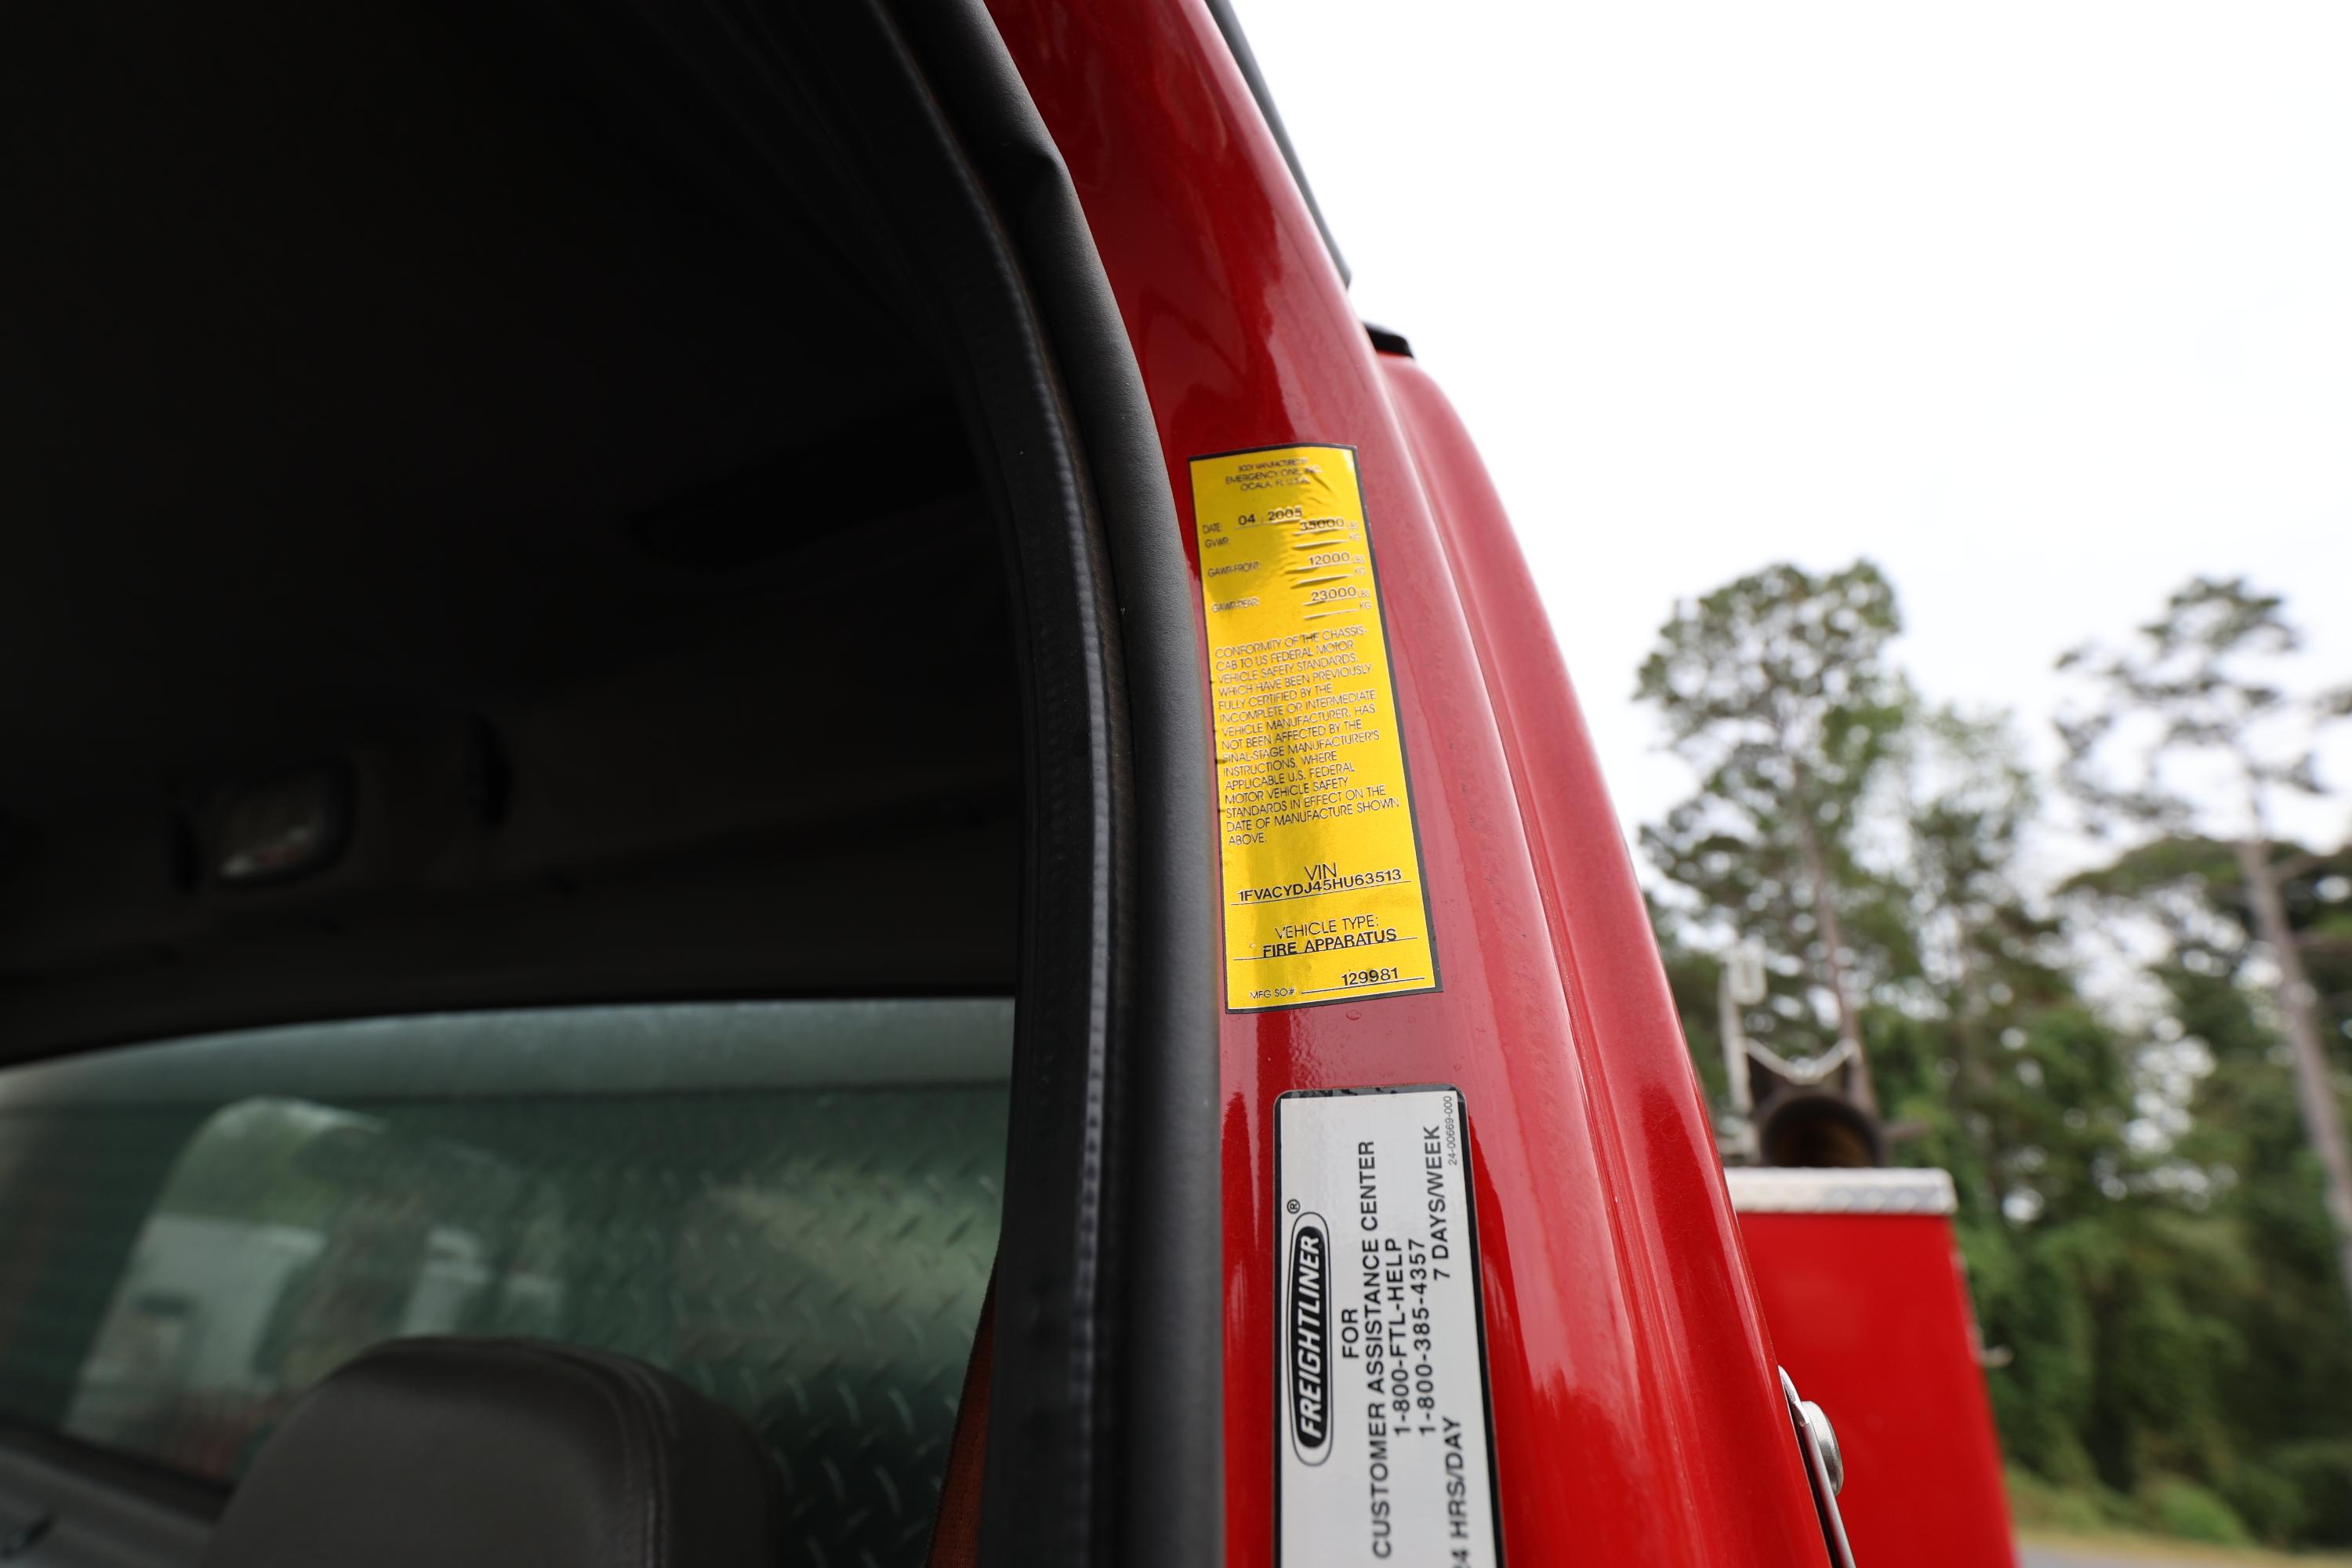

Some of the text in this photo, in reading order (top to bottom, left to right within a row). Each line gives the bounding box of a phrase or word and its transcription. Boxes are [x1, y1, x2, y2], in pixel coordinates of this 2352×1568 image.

[1225, 470, 1278, 485] EMERGENCY
[1238, 514, 1256, 525] 04
[1268, 507, 1302, 522] 2005
[1300, 517, 1345, 532] 35000
[1309, 551, 1350, 565] 12000
[1311, 586, 1356, 601] 23000
[1359, 601, 1372, 610] KG
[1215, 639, 1281, 658] CONFORMITY
[1284, 636, 1298, 647] OF
[1301, 632, 1319, 643] THE
[1216, 640, 1355, 671] CAB TO US FEDERAL MOTOR
[1218, 670, 1258, 684] VEHICLE
[1261, 663, 1294, 678] SAFETY
[1218, 663, 1372, 697] WHICH HAVE BEEN PREVIOUSLY
[1218, 683, 1332, 710] FULLY CERTIFIED BY THE
[1220, 689, 1377, 723] INCOMPLETE OR INTERMEDIATE
[1221, 722, 1263, 737] VEHICLE
[1354, 702, 1375, 716] HAS
[1221, 719, 1362, 750] NOT BEEN AFFECTED BY THE
[1222, 730, 1380, 764] FINAL-STAGE MANUFACTURER'S
[1301, 750, 1338, 765] WHERE
[1225, 762, 1355, 791] APPLICABLE U.S. FEDERAL
[1225, 776, 1348, 804] MOTOR VEHICLE SAFETY
[1226, 785, 1386, 818] STANDARDS IN EFFECT ON THE
[1226, 797, 1399, 833] DATE OF MANUFACTURE SHOWN
[1229, 832, 1267, 846] ABOVE.
[1238, 869, 1402, 902] 1FVACYDJ45HU63513
[1305, 862, 1338, 880] VIN
[1275, 914, 1379, 939] VEHICLE TYPE:
[1263, 928, 1397, 958] FIRE APPARATUS
[1341, 967, 1399, 986] 129981
[1250, 986, 1295, 999] MFG SO#
[1443, 1095, 1457, 1167] 24-00669-000
[1298, 1235, 1323, 1439] FREIGHTLINER
[1341, 1308, 1359, 1359] FOR
[1385, 1238, 1411, 1436] 1-800-FTL-HELP
[1408, 1239, 1436, 1436] 1-800-385-4357
[1423, 1126, 1472, 1568] 4 HRS/DAY 7 DAYS/WEEK
[1358, 1142, 1392, 1559] CUSTOMER ASSISTANCE CENTER
